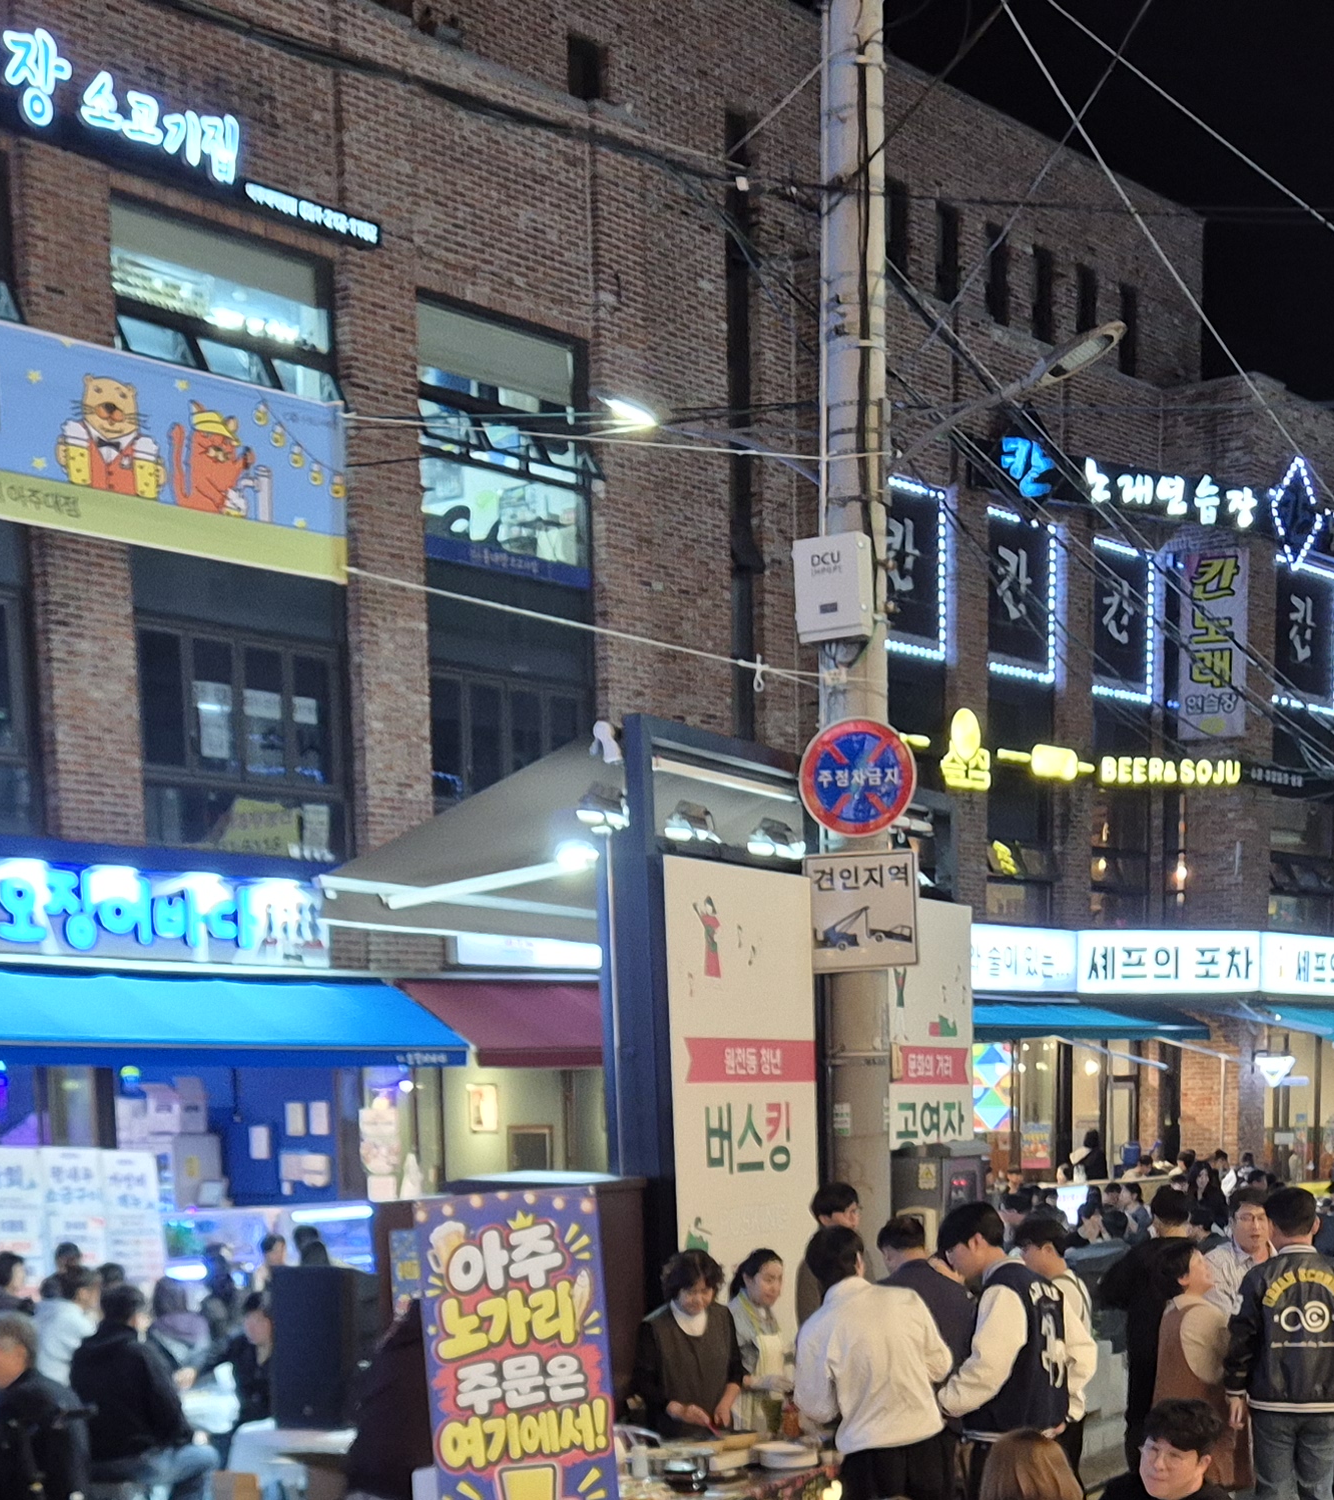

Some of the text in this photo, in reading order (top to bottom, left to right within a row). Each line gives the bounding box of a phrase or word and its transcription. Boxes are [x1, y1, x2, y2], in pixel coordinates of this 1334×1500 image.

[79, 70, 240, 185] 소고기집
[1001, 436, 1259, 529] 칸 노래연습장
[810, 550, 841, 567] DCU
[1184, 693, 1238, 716] 연습장
[817, 768, 900, 789] 주정차금지
[814, 862, 910, 892] 견인지역
[1087, 945, 1253, 981] 셰프의 포차
[724, 1047, 757, 1075] 원천동
[907, 1053, 953, 1078] 문화의 거리
[704, 1101, 792, 1175] 버스킹
[448, 1223, 564, 1292] 아주
[437, 1279, 577, 1360] 노가리
[455, 1354, 586, 1415] 주문은
[439, 1397, 608, 1469] 여기에서!
